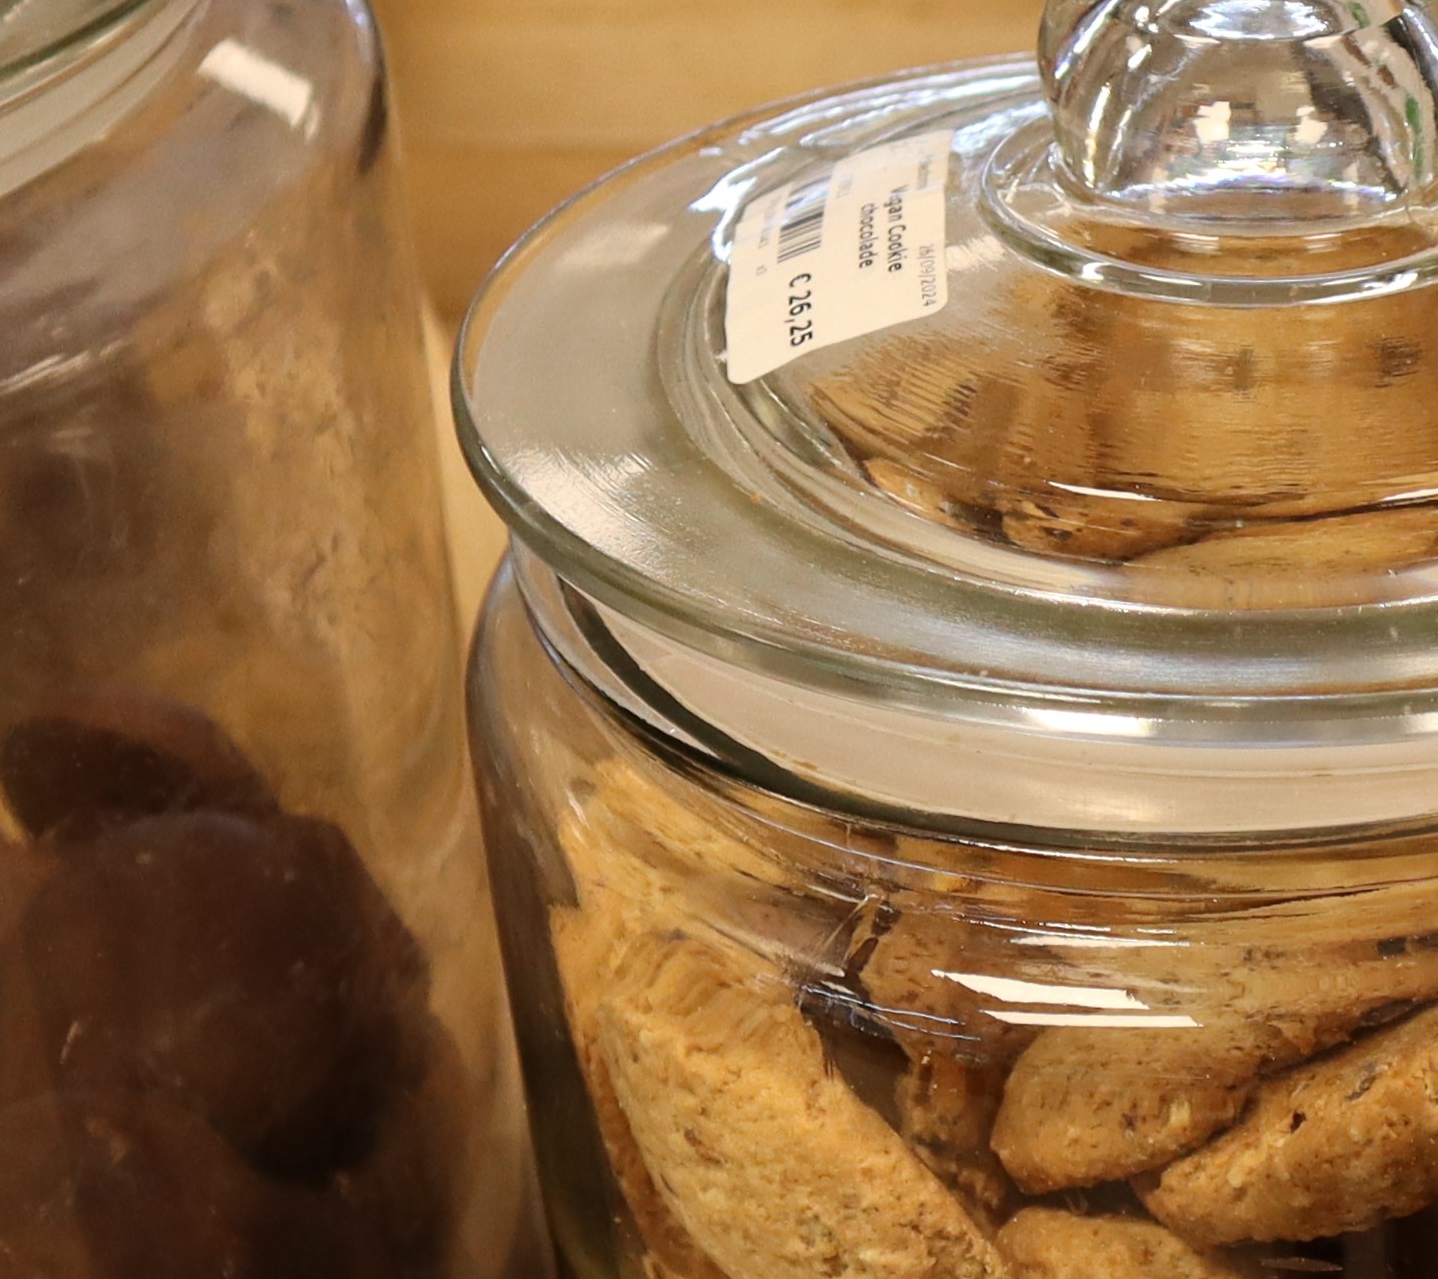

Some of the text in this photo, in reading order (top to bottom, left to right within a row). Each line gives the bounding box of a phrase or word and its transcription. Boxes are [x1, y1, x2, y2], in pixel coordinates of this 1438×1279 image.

[858, 202, 881, 270] chocolade
[883, 183, 910, 273] Vgan Cookie
[783, 272, 813, 348] € 26,25
[916, 243, 938, 308] 26/09/2024
